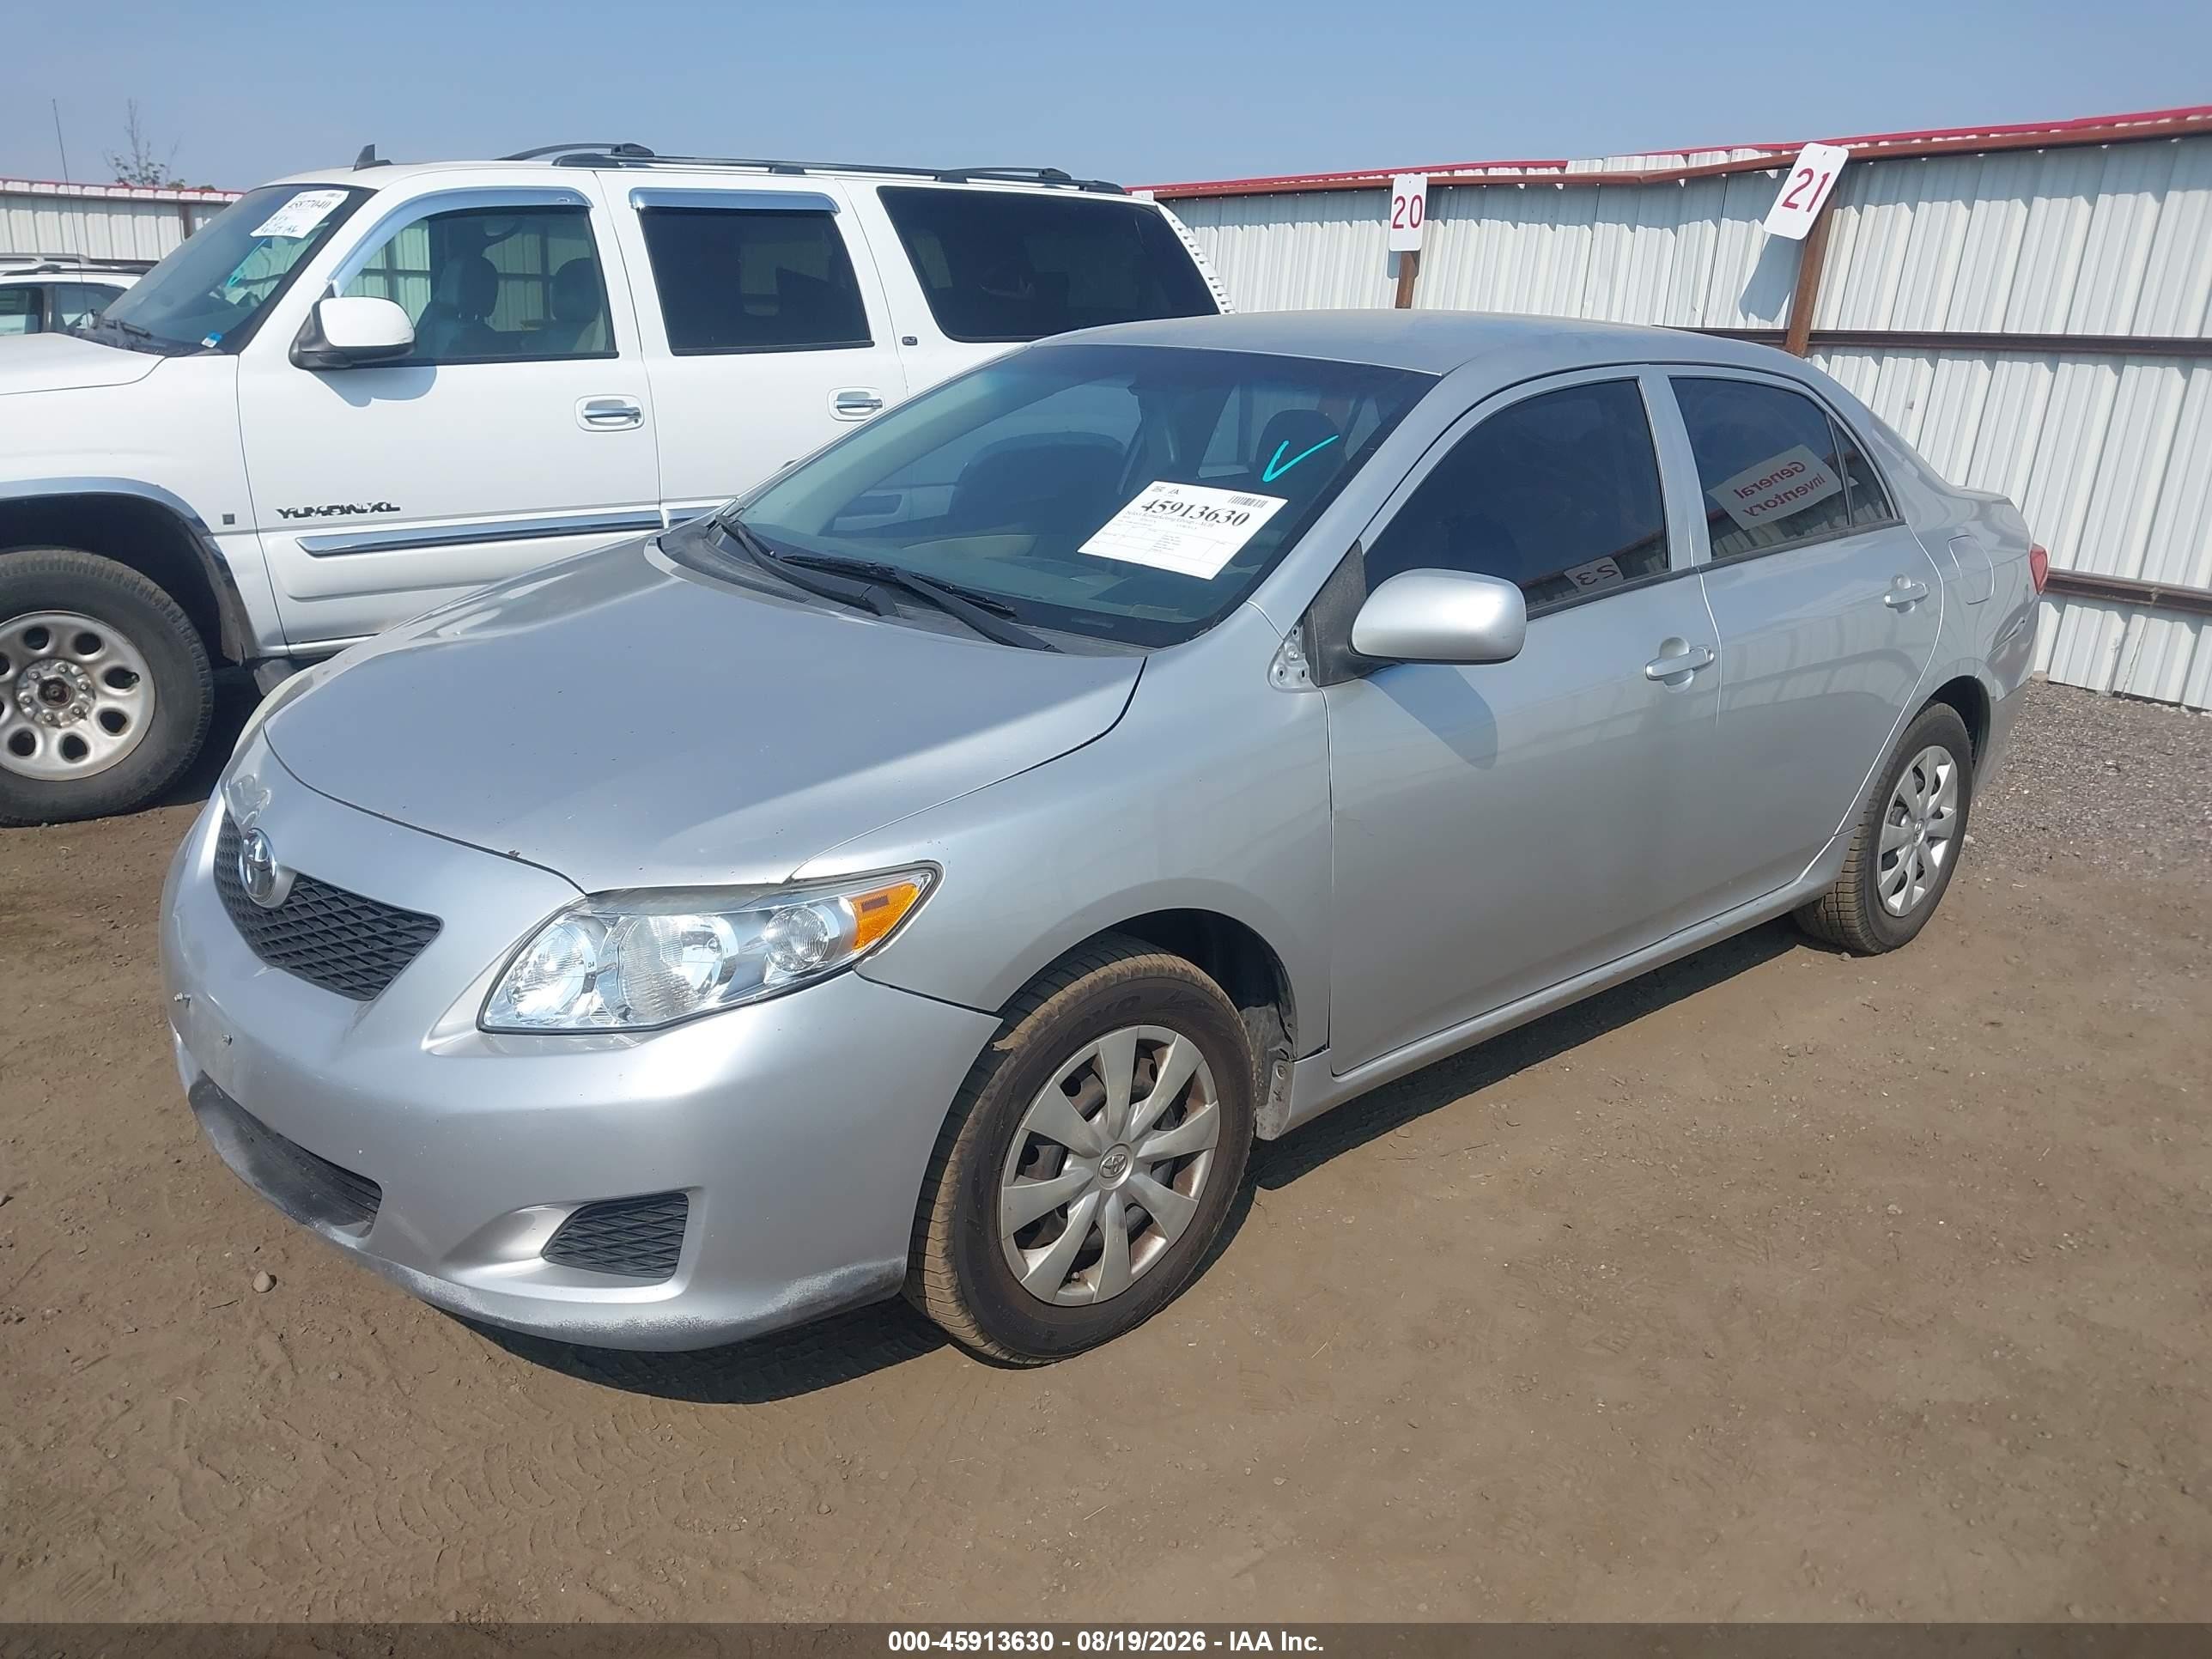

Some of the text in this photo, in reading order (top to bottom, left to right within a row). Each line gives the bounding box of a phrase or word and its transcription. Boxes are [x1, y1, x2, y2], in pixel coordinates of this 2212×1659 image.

[1781, 168, 1831, 213] 21
[1392, 194, 1424, 229] 20
[367, 501, 401, 514] XL
[1140, 498, 1251, 527] 45913630
